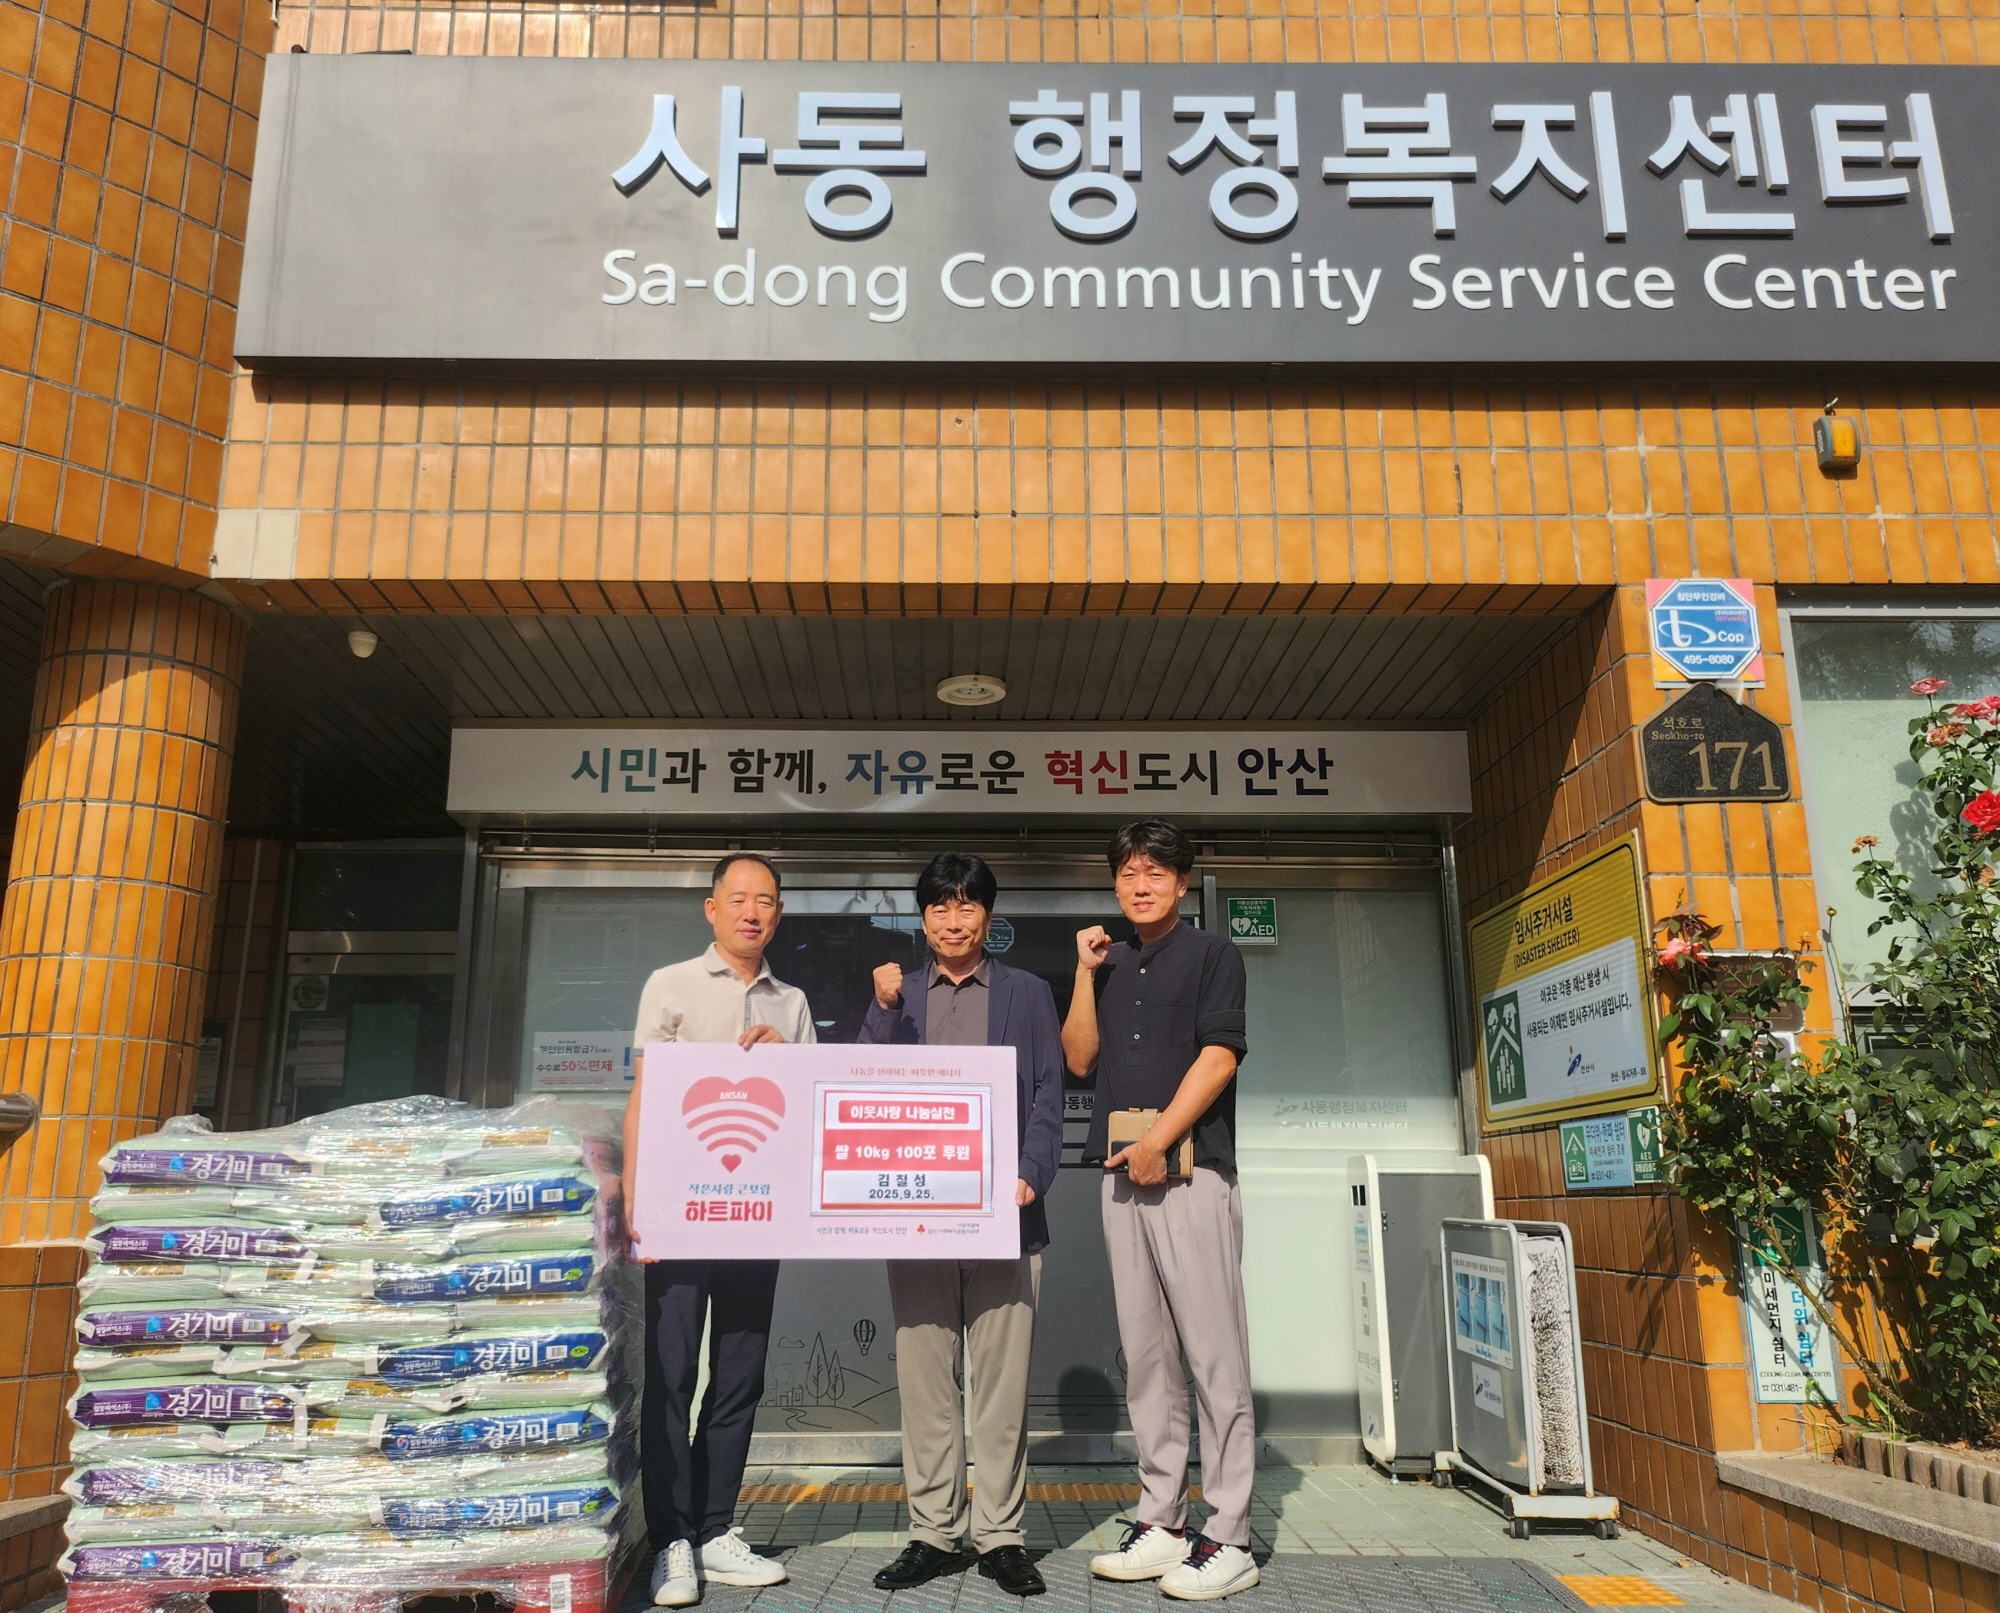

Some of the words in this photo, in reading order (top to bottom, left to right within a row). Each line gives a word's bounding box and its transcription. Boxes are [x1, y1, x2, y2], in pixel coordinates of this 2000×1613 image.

[611, 85, 926, 240] 사동
[1009, 88, 1955, 242] 행정복지센터
[602, 247, 908, 323] Sa-dong
[940, 251, 1382, 325] Community
[1408, 251, 1675, 310] Service
[1703, 253, 1956, 310] Center
[1683, 654, 1734, 664] 495-8080
[1652, 730, 1705, 741] Seokho-ro
[1661, 717, 1704, 730] 석호로
[571, 748, 707, 796] 시민과
[729, 747, 828, 798] 함께,
[844, 748, 1025, 796] 자유로운
[1045, 748, 1219, 796] 혁신도시
[1237, 747, 1335, 796] 안산
[1688, 741, 1782, 791] 171
[1249, 925, 1274, 936] AED
[1514, 893, 1573, 945] 임시주거시설
[1514, 942, 1546, 971] (DISASTER
[1547, 926, 1580, 955] SHELTER)
[1540, 985, 1557, 1003] 이곳은
[1559, 979, 1571, 997] 각종
[1572, 973, 1585, 992] 재난
[1586, 967, 1601, 988] 발생
[1602, 964, 1610, 983] 시
[1526, 1019, 1549, 1039] 사용되는
[1549, 1012, 1568, 1031] 이재민
[1568, 992, 1632, 1026] 임시주거시설입니다.
[540, 1045, 598, 1054] 무인민원발급기
[561, 1061, 588, 1072] 50%
[588, 1060, 613, 1072] 면제
[719, 1091, 748, 1100] ANSAN
[1302, 1100, 1408, 1115] 사동행정복지센터
[850, 1105, 902, 1120] 이웃사랑
[905, 1106, 956, 1120] 나눔실천
[188, 1153, 253, 1181] 경기미
[834, 1145, 849, 1160] 쌀
[855, 1146, 890, 1161] 10kg
[895, 1145, 937, 1160] 100포
[942, 1144, 970, 1161] 후원
[470, 1184, 534, 1215] 경기미
[688, 1183, 734, 1195] 작은사랑
[869, 1189, 935, 1200] 2025.9.25.
[685, 1200, 773, 1222] 하트파이
[182, 1230, 248, 1256] 경기미
[467, 1263, 532, 1293] 경기미
[1763, 1271, 1782, 1332] 미세먼지
[166, 1312, 236, 1339] 경기미
[472, 1340, 539, 1370] 경기미
[1771, 1336, 1786, 1367] 쉼터
[166, 1388, 232, 1418] 경기미
[482, 1417, 549, 1450] 경기미
[482, 1496, 549, 1528] 경기미
[163, 1546, 232, 1576] 경기미
